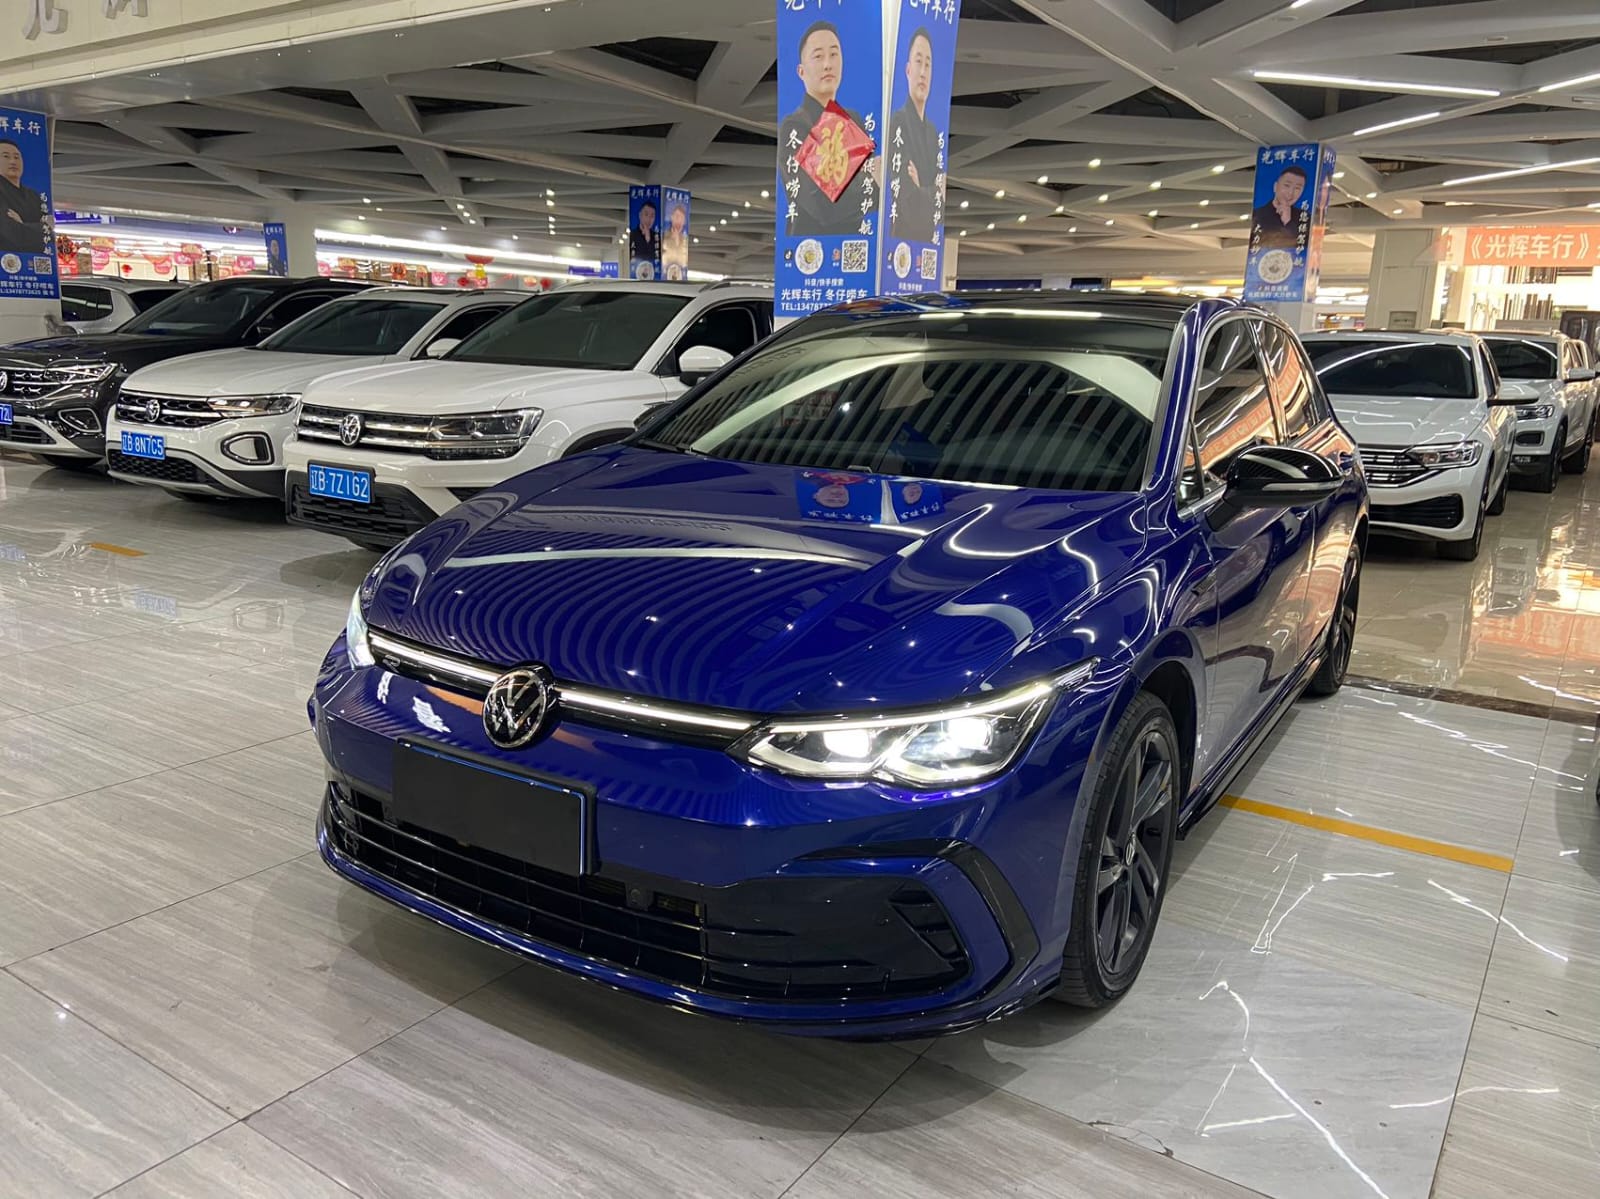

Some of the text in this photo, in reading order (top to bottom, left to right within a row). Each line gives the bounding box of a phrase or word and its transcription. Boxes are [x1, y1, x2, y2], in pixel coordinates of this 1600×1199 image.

[858, 112, 876, 236] 为保驾护航
[1471, 233, 1600, 260] 《光辉车行》
[781, 288, 822, 301] 光辉车行
